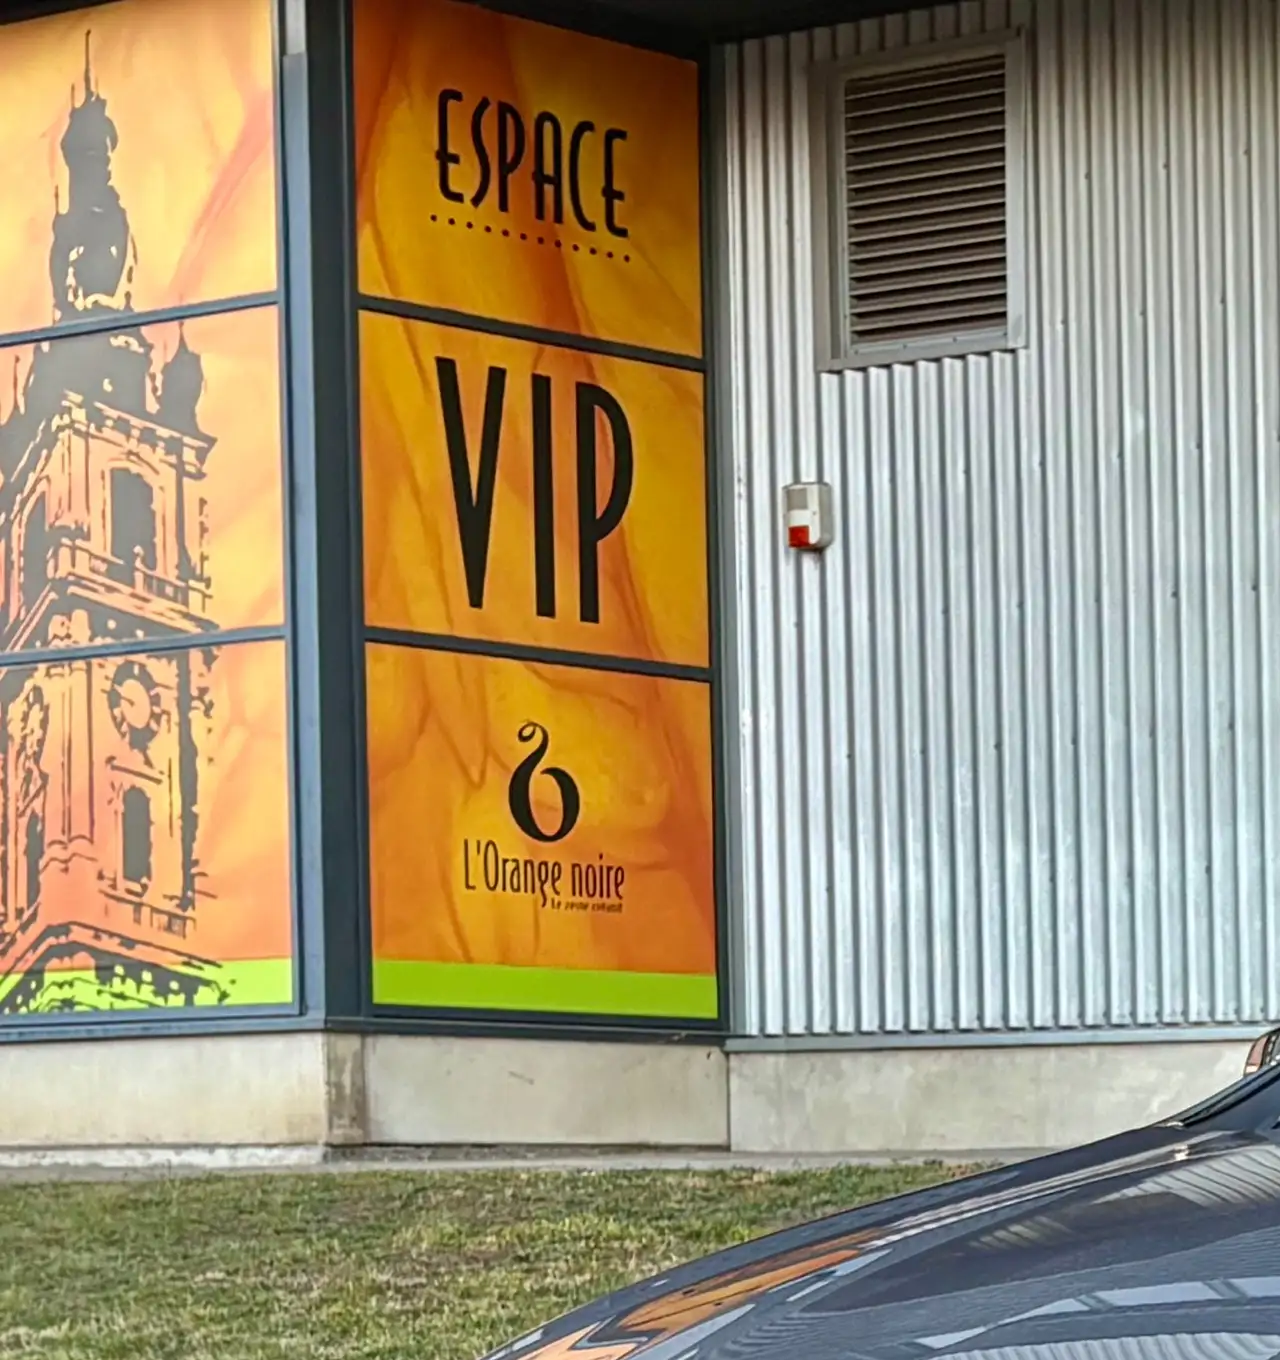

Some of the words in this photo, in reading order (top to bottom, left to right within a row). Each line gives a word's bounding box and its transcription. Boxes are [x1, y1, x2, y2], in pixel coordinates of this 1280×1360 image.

[435, 88, 629, 238] ESPACE
[435, 356, 634, 624] VIP
[463, 838, 562, 908] L'Orange
[571, 853, 625, 899] noire
